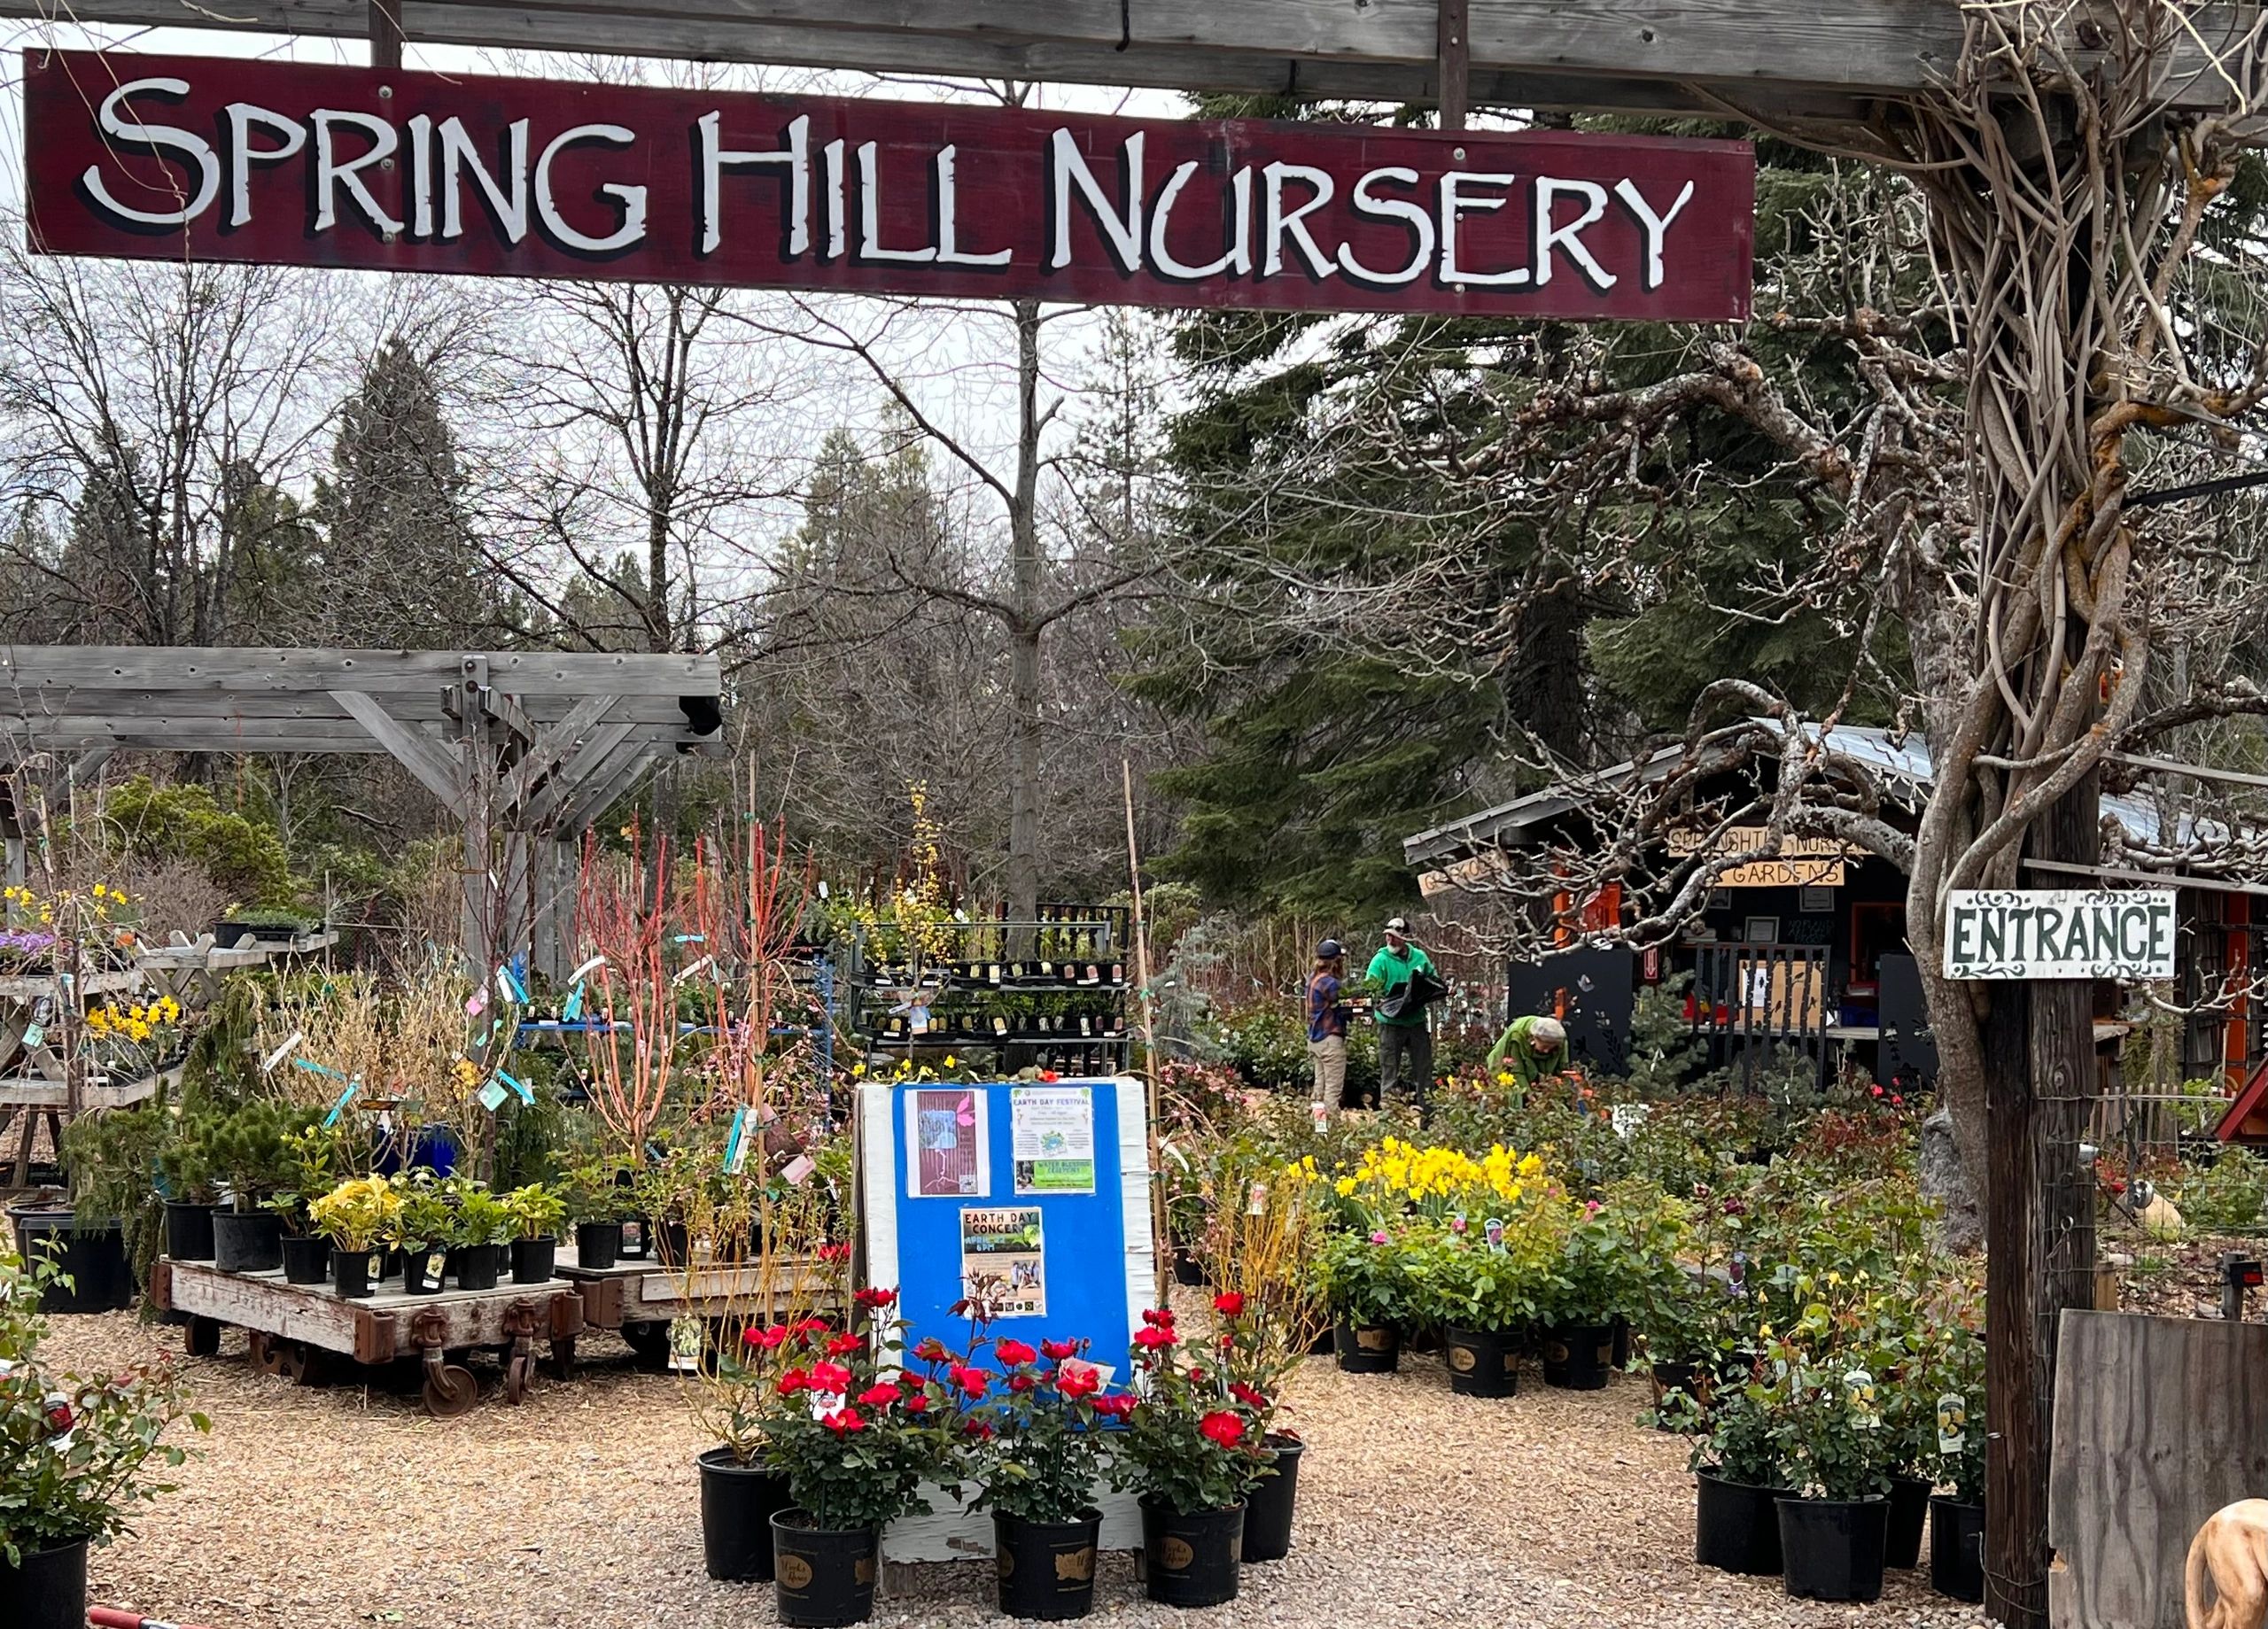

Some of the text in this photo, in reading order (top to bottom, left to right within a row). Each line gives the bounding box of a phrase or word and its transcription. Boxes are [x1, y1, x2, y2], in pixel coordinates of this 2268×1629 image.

[83, 77, 1694, 290] SPRING HILL NURSERY
[1733, 863, 1838, 883] GARDENS
[1952, 905, 2171, 963] ENTRANCE
[965, 1212, 1034, 1224] EARTH DAY
